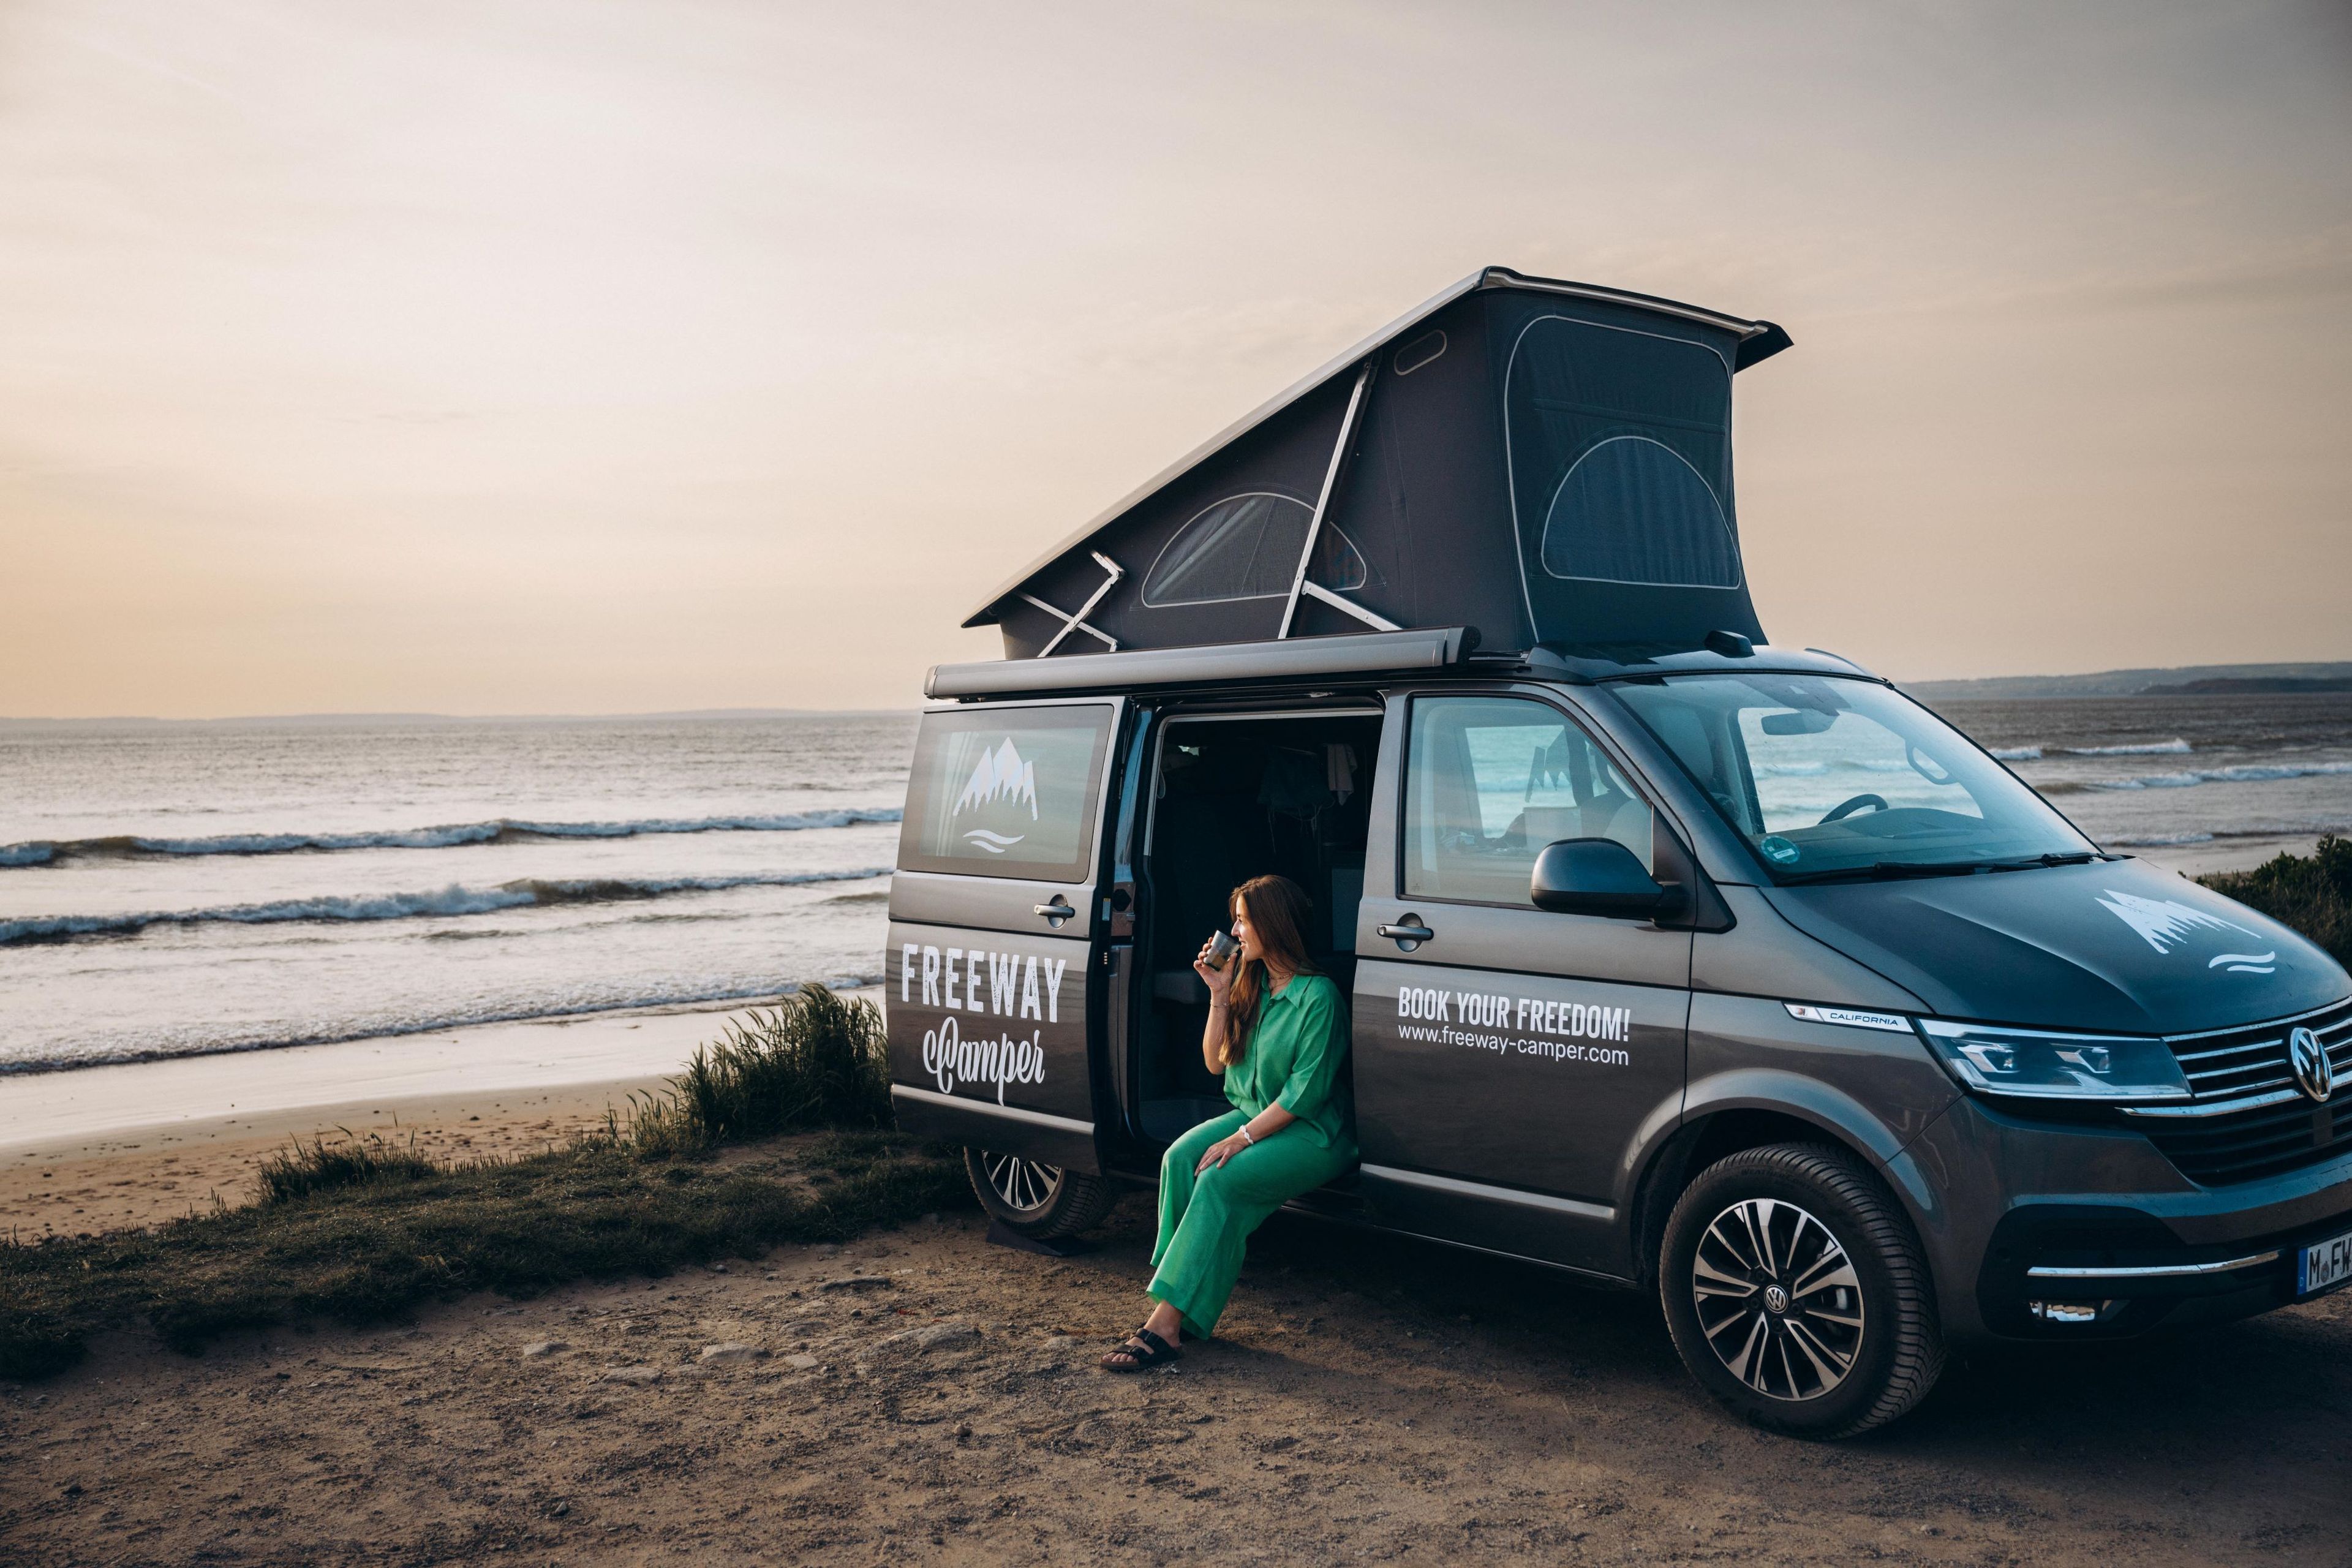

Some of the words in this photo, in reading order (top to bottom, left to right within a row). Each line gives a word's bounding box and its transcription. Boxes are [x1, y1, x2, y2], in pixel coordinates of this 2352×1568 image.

[902, 943, 1066, 1023] FREEWAY
[1398, 986, 1451, 1022] BOOK
[1457, 992, 1510, 1029] YOUR
[1517, 998, 1631, 1042] FREEDOM!
[1830, 1012, 1898, 1026] CALIFORNIA
[922, 1016, 1045, 1106] Camper
[1398, 1025, 1629, 1066] www.freeway-camper.com
[2299, 1276, 2304, 1287] D
[2309, 1249, 2321, 1286] M
